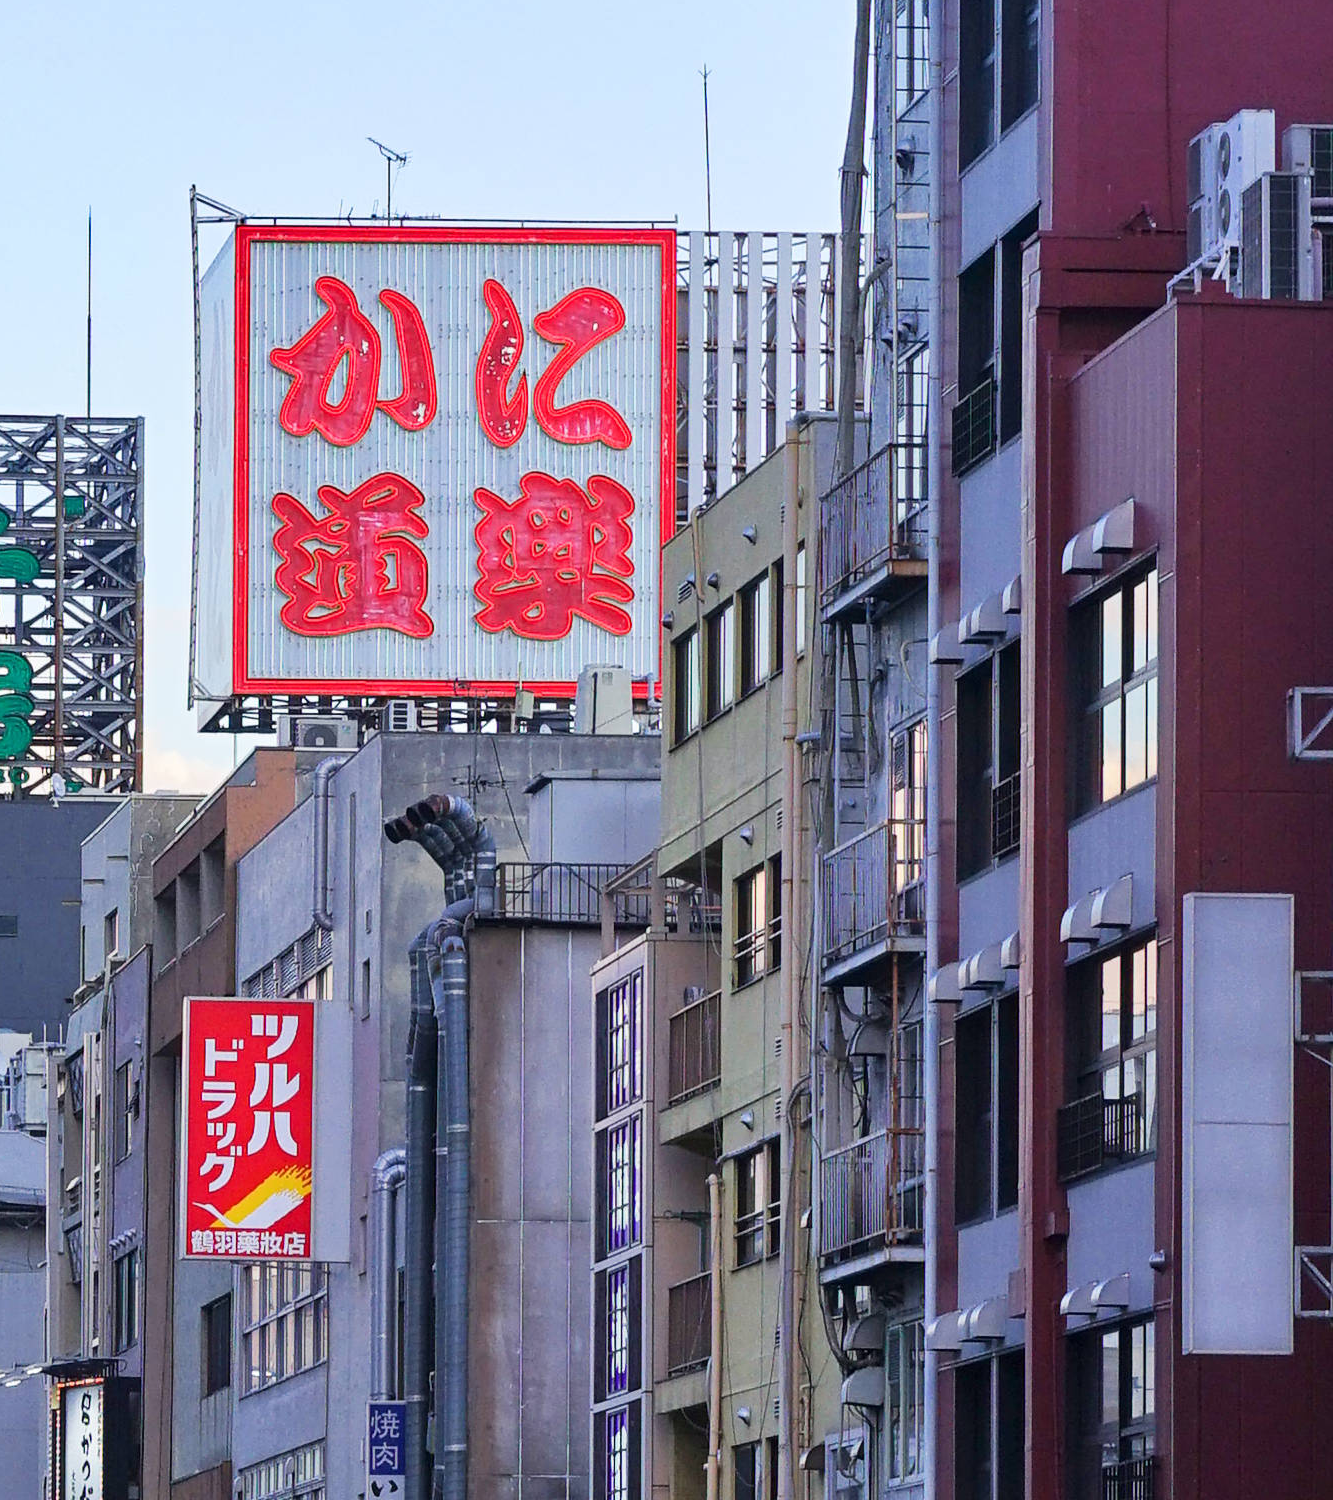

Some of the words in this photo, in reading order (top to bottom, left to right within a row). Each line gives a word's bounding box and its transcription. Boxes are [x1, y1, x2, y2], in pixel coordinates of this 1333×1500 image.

[270, 274, 633, 451] かに
[199, 1037, 245, 1193] ドラッグ
[247, 1014, 300, 1157] ツルハ
[371, 1409, 400, 1470] 焼肉
